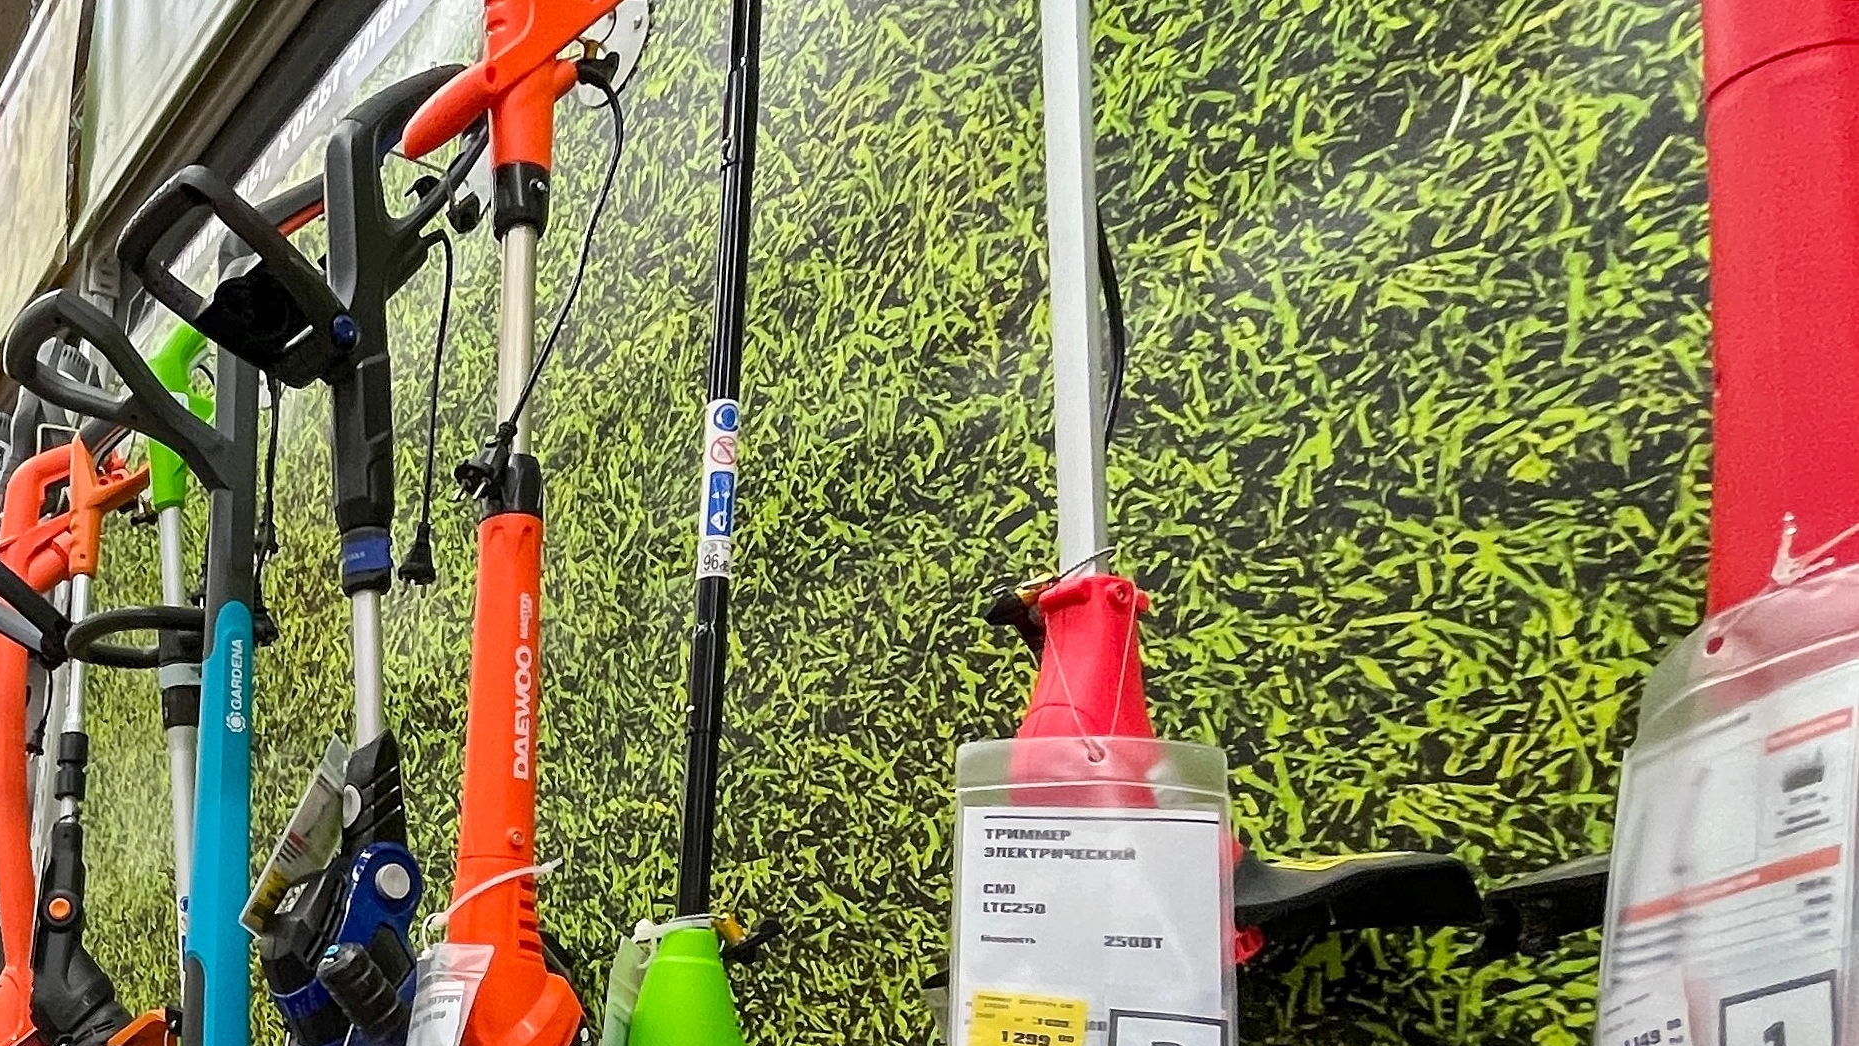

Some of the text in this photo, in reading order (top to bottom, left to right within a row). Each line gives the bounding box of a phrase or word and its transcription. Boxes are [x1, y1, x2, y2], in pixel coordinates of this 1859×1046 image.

[277, 65, 342, 159] КОСЫ
[703, 554, 719, 571] 96
[230, 639, 243, 711] GARDENA
[513, 645, 533, 780] DAEWOO
[984, 828, 1072, 841] ТРИММЕР
[983, 846, 1137, 861] ЭЛЕКТРИЧЕСКИЙ
[983, 883, 1016, 895] CMI
[982, 901, 1047, 915] LTC250
